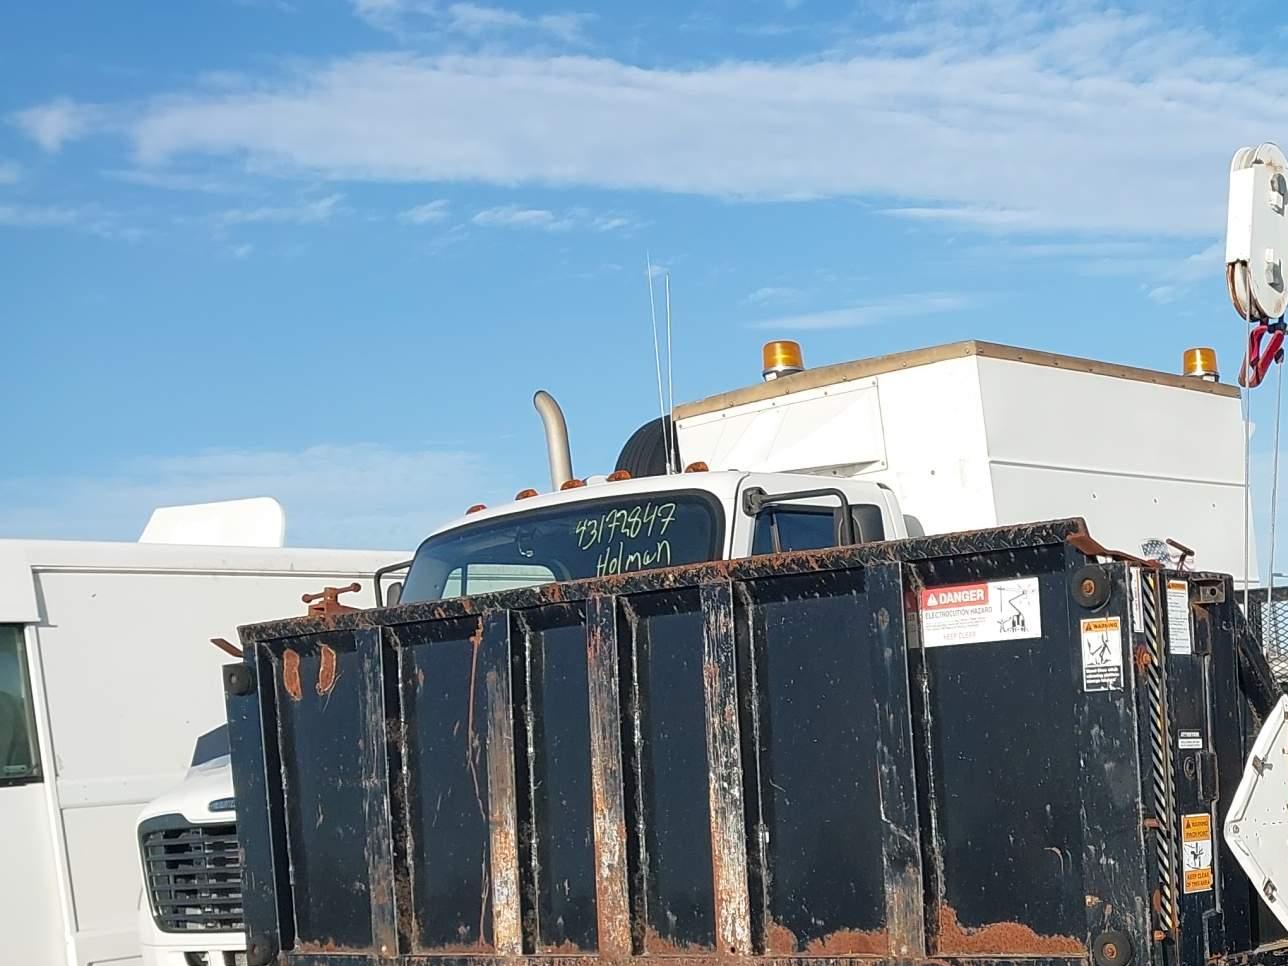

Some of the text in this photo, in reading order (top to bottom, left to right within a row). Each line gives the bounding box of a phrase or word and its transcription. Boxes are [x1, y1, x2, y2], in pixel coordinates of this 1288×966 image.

[575, 502, 676, 550] 43172847
[596, 540, 671, 578] Holman
[938, 588, 985, 604] DANGER
[925, 606, 993, 619] ELECTROCUTION HAZARD
